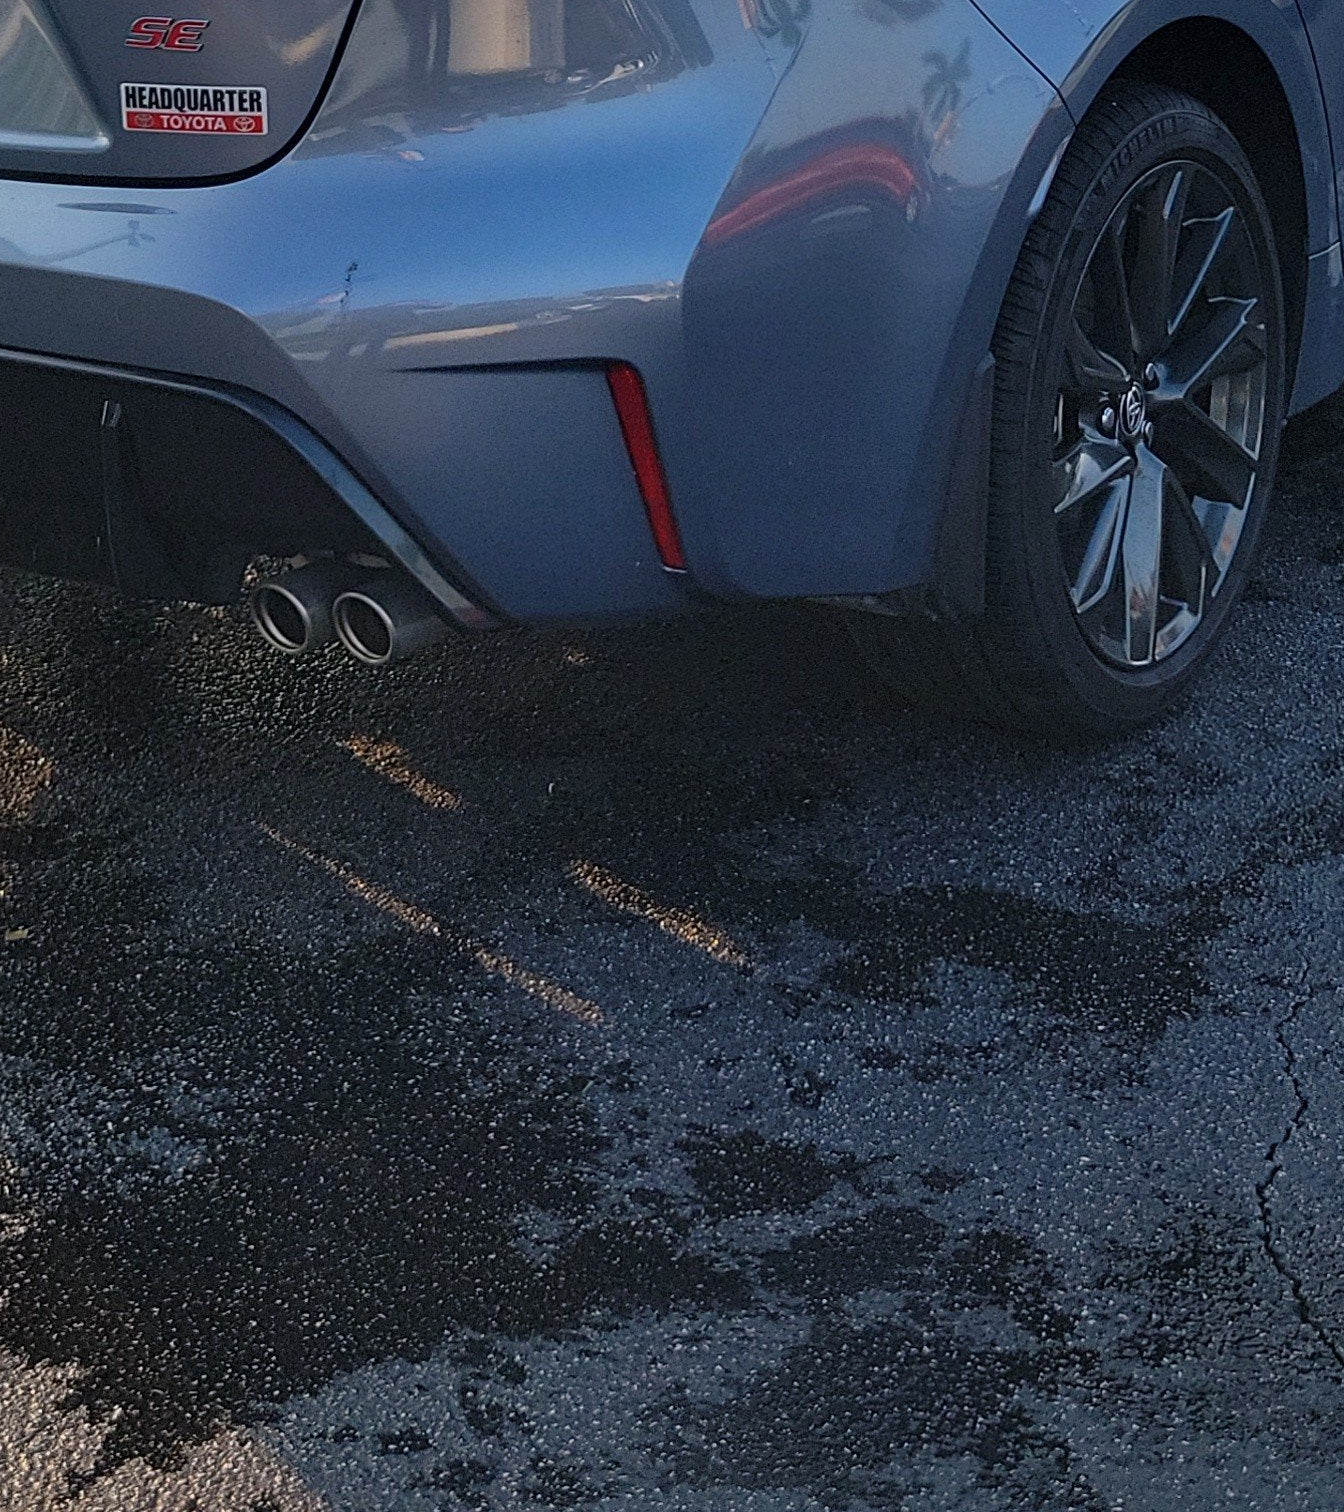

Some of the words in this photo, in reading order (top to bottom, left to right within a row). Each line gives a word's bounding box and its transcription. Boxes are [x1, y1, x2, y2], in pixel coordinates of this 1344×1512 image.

[125, 16, 210, 52] SE
[125, 85, 263, 113] HEADQUARTER
[160, 114, 227, 131] TOYOTA
